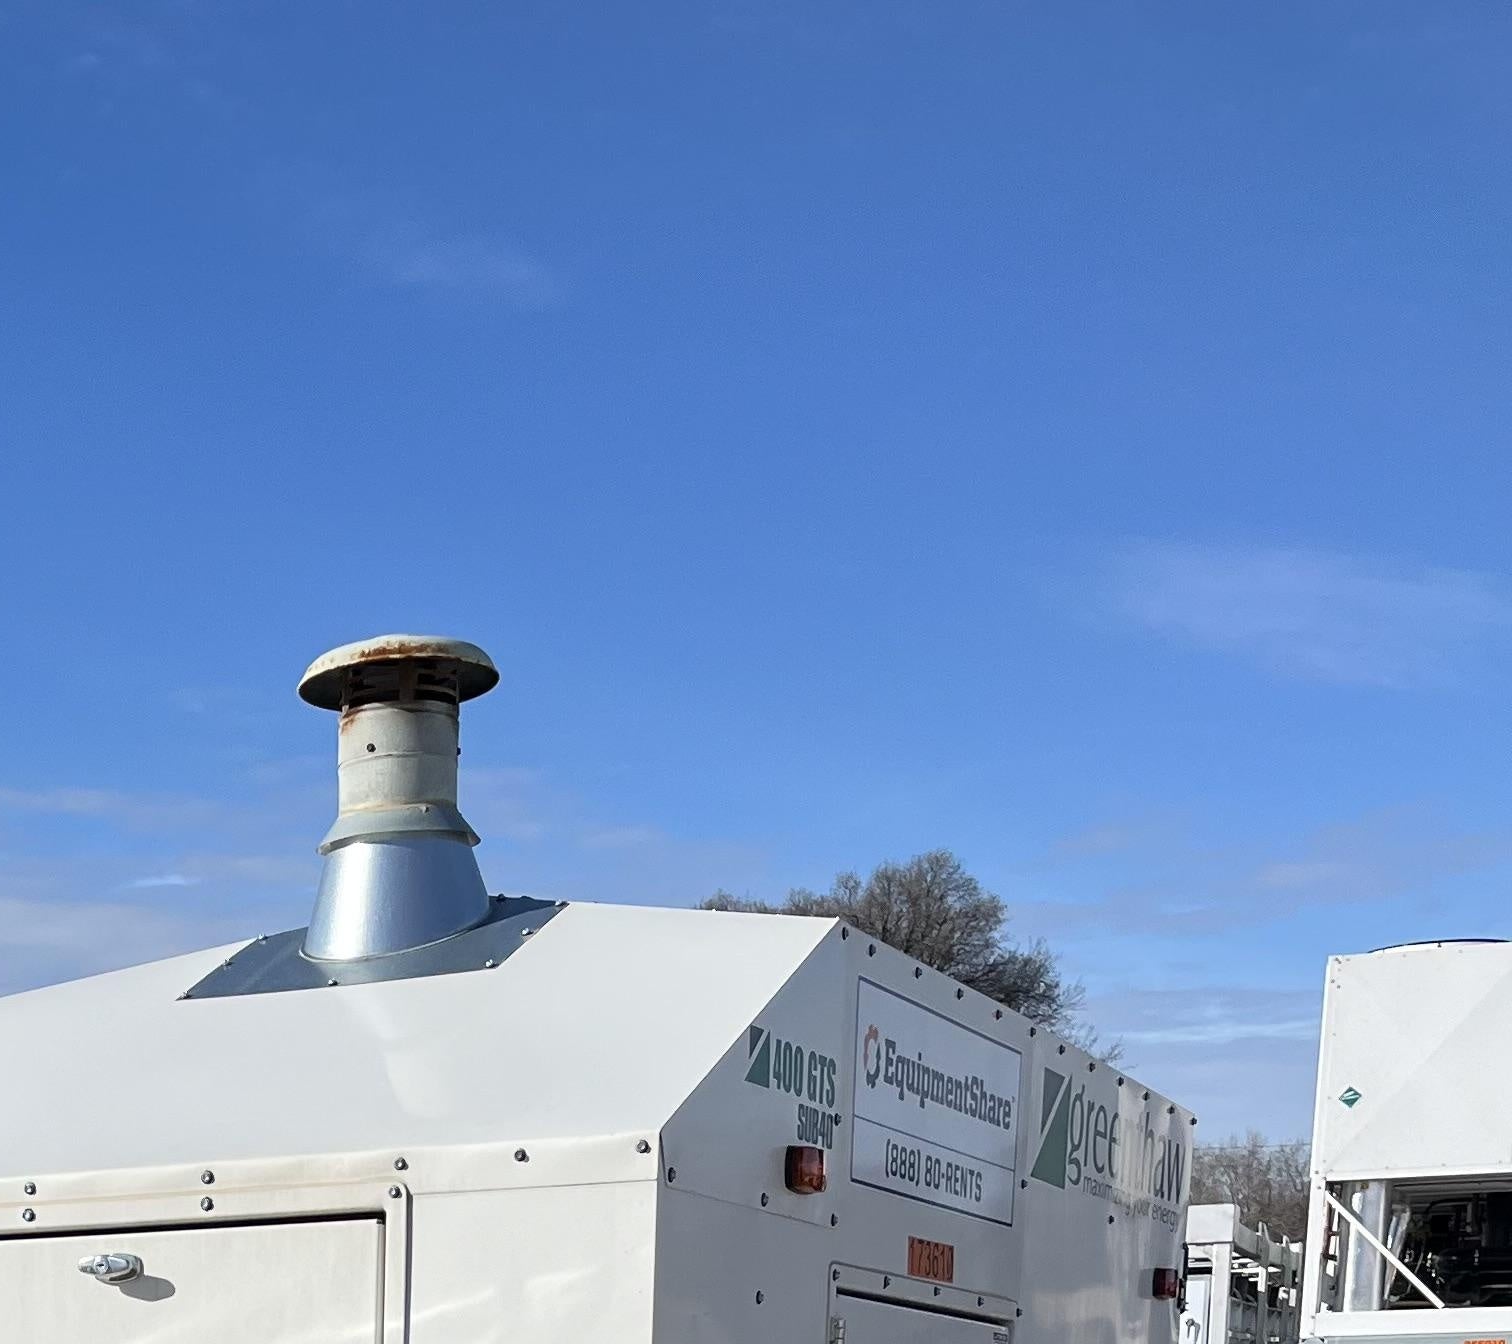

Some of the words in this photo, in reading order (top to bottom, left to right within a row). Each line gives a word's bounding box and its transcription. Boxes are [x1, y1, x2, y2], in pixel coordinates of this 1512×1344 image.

[772, 1038, 804, 1097] 400
[807, 1051, 836, 1108] GTS
[884, 1038, 1012, 1131] EquipmentShare
[797, 1103, 833, 1149] SUB40
[885, 1138, 920, 1187] (888)
[925, 1155, 982, 1202] 80-RENTS
